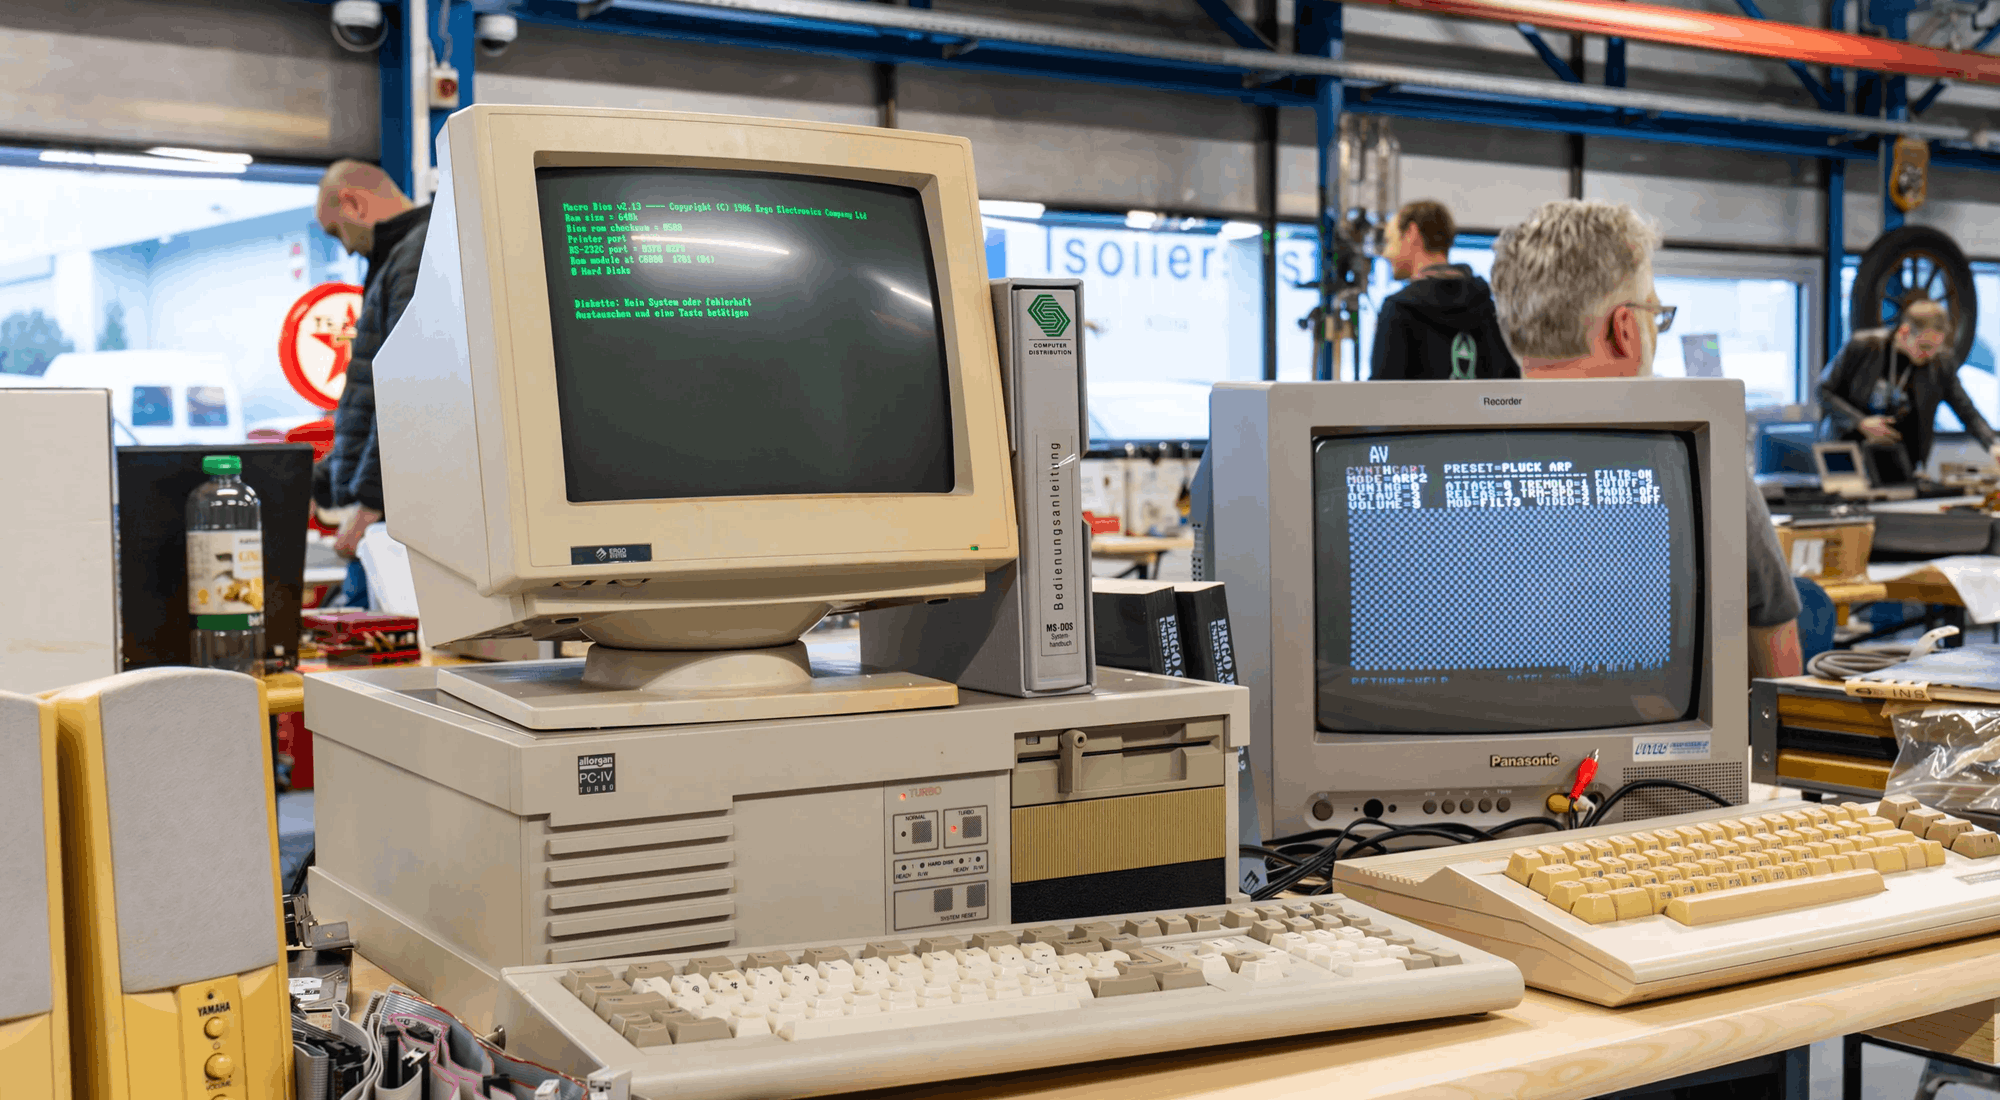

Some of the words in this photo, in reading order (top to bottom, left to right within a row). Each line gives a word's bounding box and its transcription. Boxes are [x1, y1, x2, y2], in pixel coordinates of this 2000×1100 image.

[562, 202, 588, 211] Macro
[592, 202, 612, 211] Bios
[616, 202, 642, 211] v2.13
[668, 202, 711, 212] Copyright
[716, 203, 729, 212] (C)
[733, 203, 751, 212] 1986
[755, 204, 773, 215] Ergo
[776, 205, 822, 217] Electronics
[825, 208, 853, 220] Company
[855, 211, 868, 220] Ltd
[584, 212, 604, 222] size
[566, 224, 587, 233] Bios
[591, 225, 607, 233] rom
[610, 223, 650, 233] checksum
[567, 234, 603, 244] Printer
[607, 235, 628, 245] port
[568, 245, 604, 254] RS-232C
[608, 245, 629, 255] port
[590, 255, 620, 265] module
[624, 255, 635, 264] at
[581, 266, 602, 275] Hard
[606, 266, 631, 275] Disks
[574, 299, 620, 309] Diskette:
[624, 298, 644, 307] Kein
[648, 297, 679, 308] System
[682, 297, 702, 307] oder
[705, 297, 752, 307] fehlerhaft
[575, 310, 631, 319] Austauschen
[635, 309, 650, 318] und
[654, 310, 674, 318] eine
[678, 308, 703, 317] Taste
[707, 308, 749, 318] betätigen
[1483, 396, 1522, 406] Recorder
[1369, 445, 1389, 463] AV
[1345, 464, 1426, 476] CYNTHCART
[1443, 462, 1542, 474] PRESET=PLUCK
[1549, 461, 1573, 472] ARP
[1346, 473, 1428, 485] MODE=ARP2
[1594, 469, 1653, 480] FILTR=ON
[1347, 482, 1420, 493] TUNING=0
[1445, 480, 1512, 491] ATTACK=0
[1519, 479, 1588, 490] TREMOLO=1
[1595, 478, 1653, 489] CUTOFF=2
[1347, 491, 1421, 502] OCTAVE=3
[1446, 488, 1513, 500] RELEAS=4
[1596, 486, 1660, 497] PADD1=OFF
[1348, 499, 1422, 510] VOLUME=9
[1446, 496, 1522, 508] MOD=FILT3
[1536, 495, 1590, 506] VIDEO=2
[1597, 495, 1661, 505] PADD2=OFF
[1050, 442, 1064, 611] Bedienungsanleitung
[1049, 640, 1072, 648] handbuch
[1159, 617, 1170, 657] USER'S
[1166, 614, 1182, 667] ERGO
[1210, 620, 1221, 661] USER'S
[1217, 618, 1233, 670] ERGO
[579, 756, 613, 766] allorgan
[1489, 753, 1560, 767] Panasonic
[579, 784, 614, 793] TURBO
[908, 786, 942, 798] TURBO
[197, 1001, 231, 1017] YAMAHA
